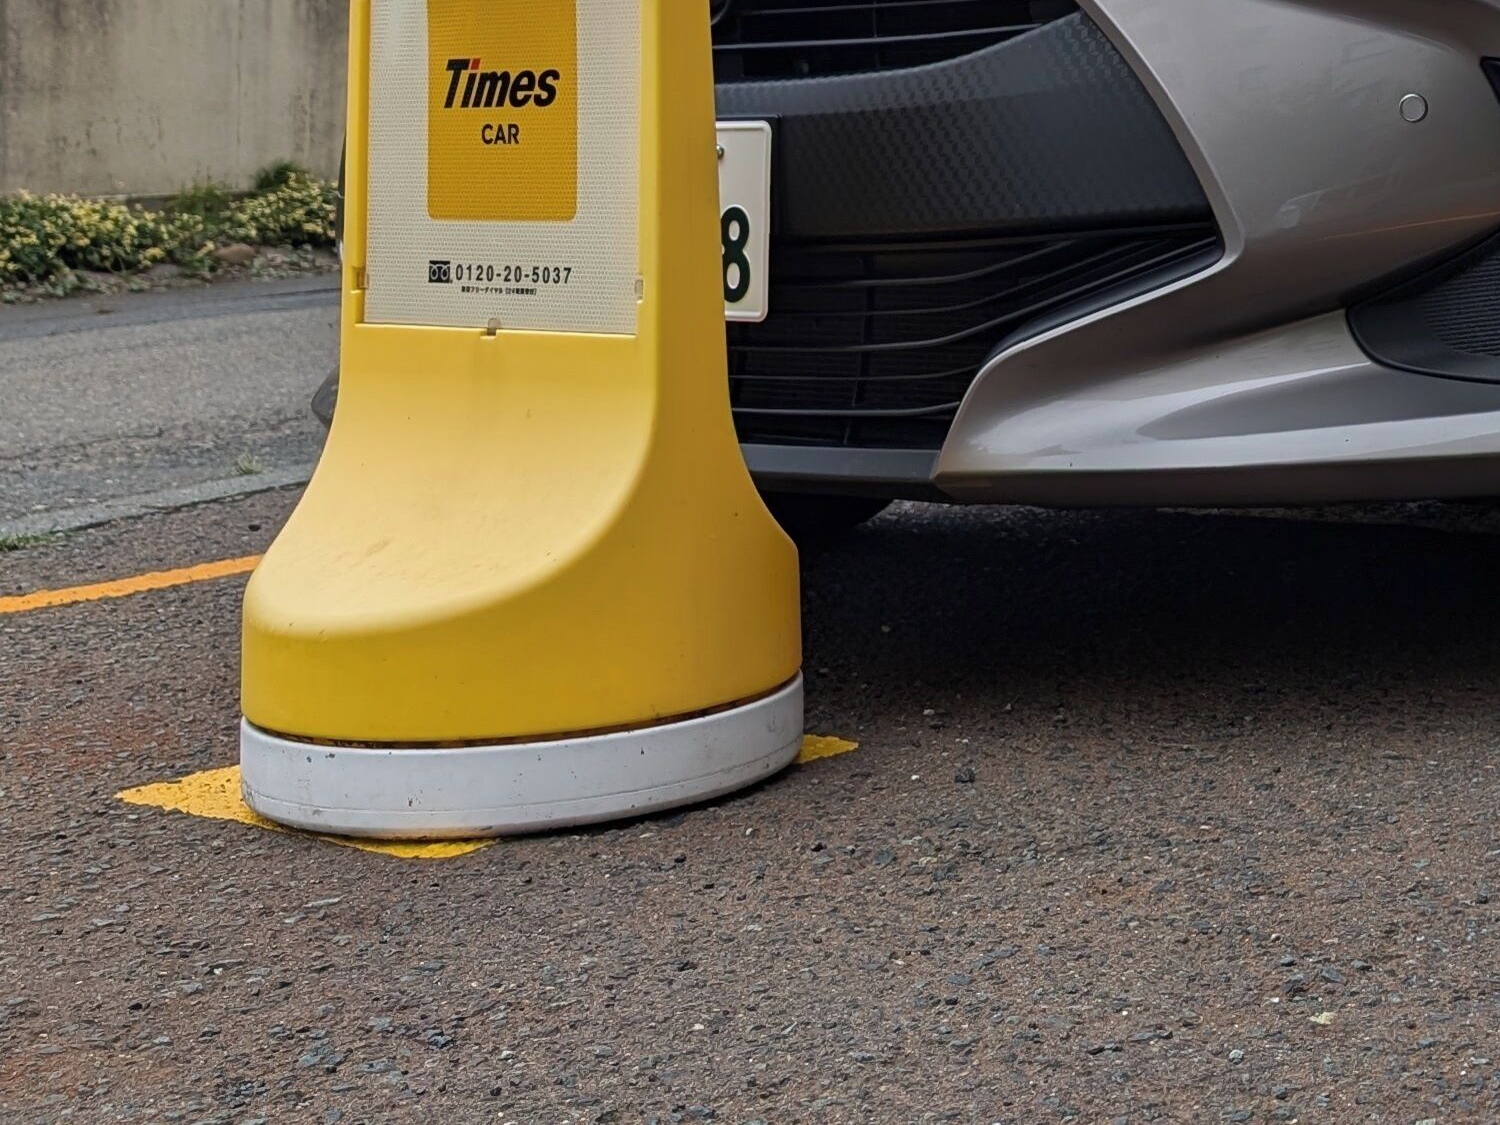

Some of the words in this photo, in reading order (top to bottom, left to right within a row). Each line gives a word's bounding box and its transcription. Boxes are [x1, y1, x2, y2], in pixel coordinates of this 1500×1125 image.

[444, 58, 560, 109] Times
[481, 123, 520, 145] CAR
[721, 206, 750, 303] 8
[455, 264, 573, 284] 0120-20-5037
